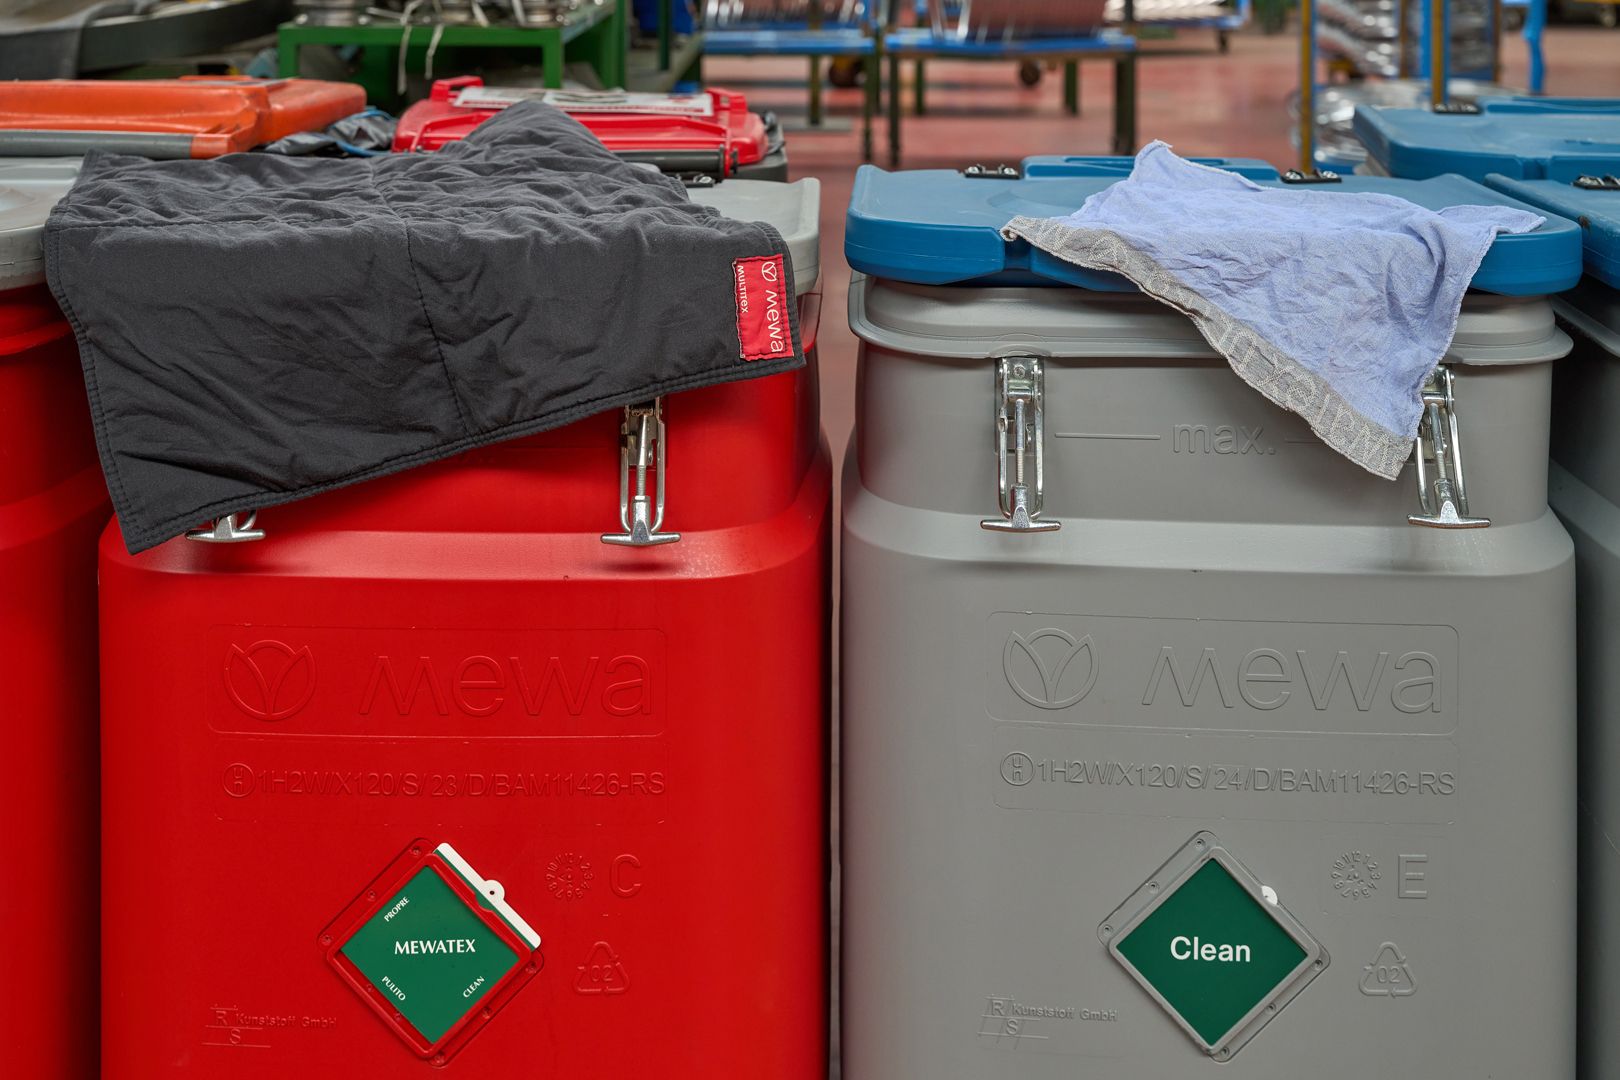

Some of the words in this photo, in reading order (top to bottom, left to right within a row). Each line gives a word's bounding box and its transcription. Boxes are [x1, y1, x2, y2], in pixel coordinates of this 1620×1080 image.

[765, 289, 784, 353] mewa
[1173, 424, 1276, 455] max.
[610, 853, 642, 898] C
[1398, 853, 1427, 899] E
[383, 896, 409, 922] PROPRE
[394, 938, 476, 955] MEWATEX
[1170, 935, 1251, 962] Clean
[591, 964, 613, 982] 02
[1377, 965, 1400, 984] 02
[381, 975, 406, 1001] PULITO
[462, 975, 485, 998] CLEAN
